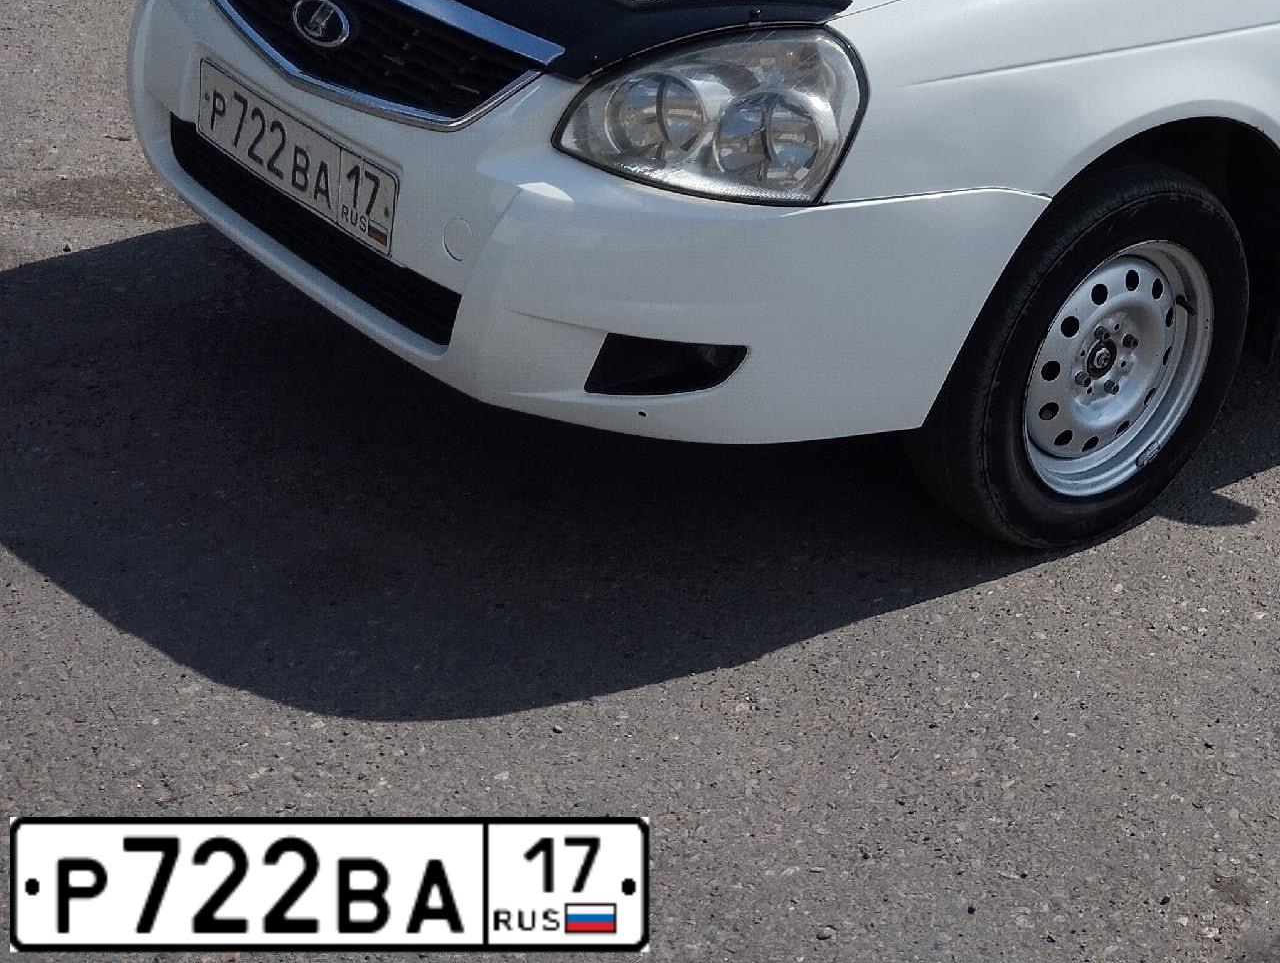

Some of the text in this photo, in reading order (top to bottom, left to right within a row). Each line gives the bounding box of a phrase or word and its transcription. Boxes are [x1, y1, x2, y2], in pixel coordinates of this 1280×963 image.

[211, 87, 382, 216] Р722ВА 17
[341, 203, 368, 234] RUS
